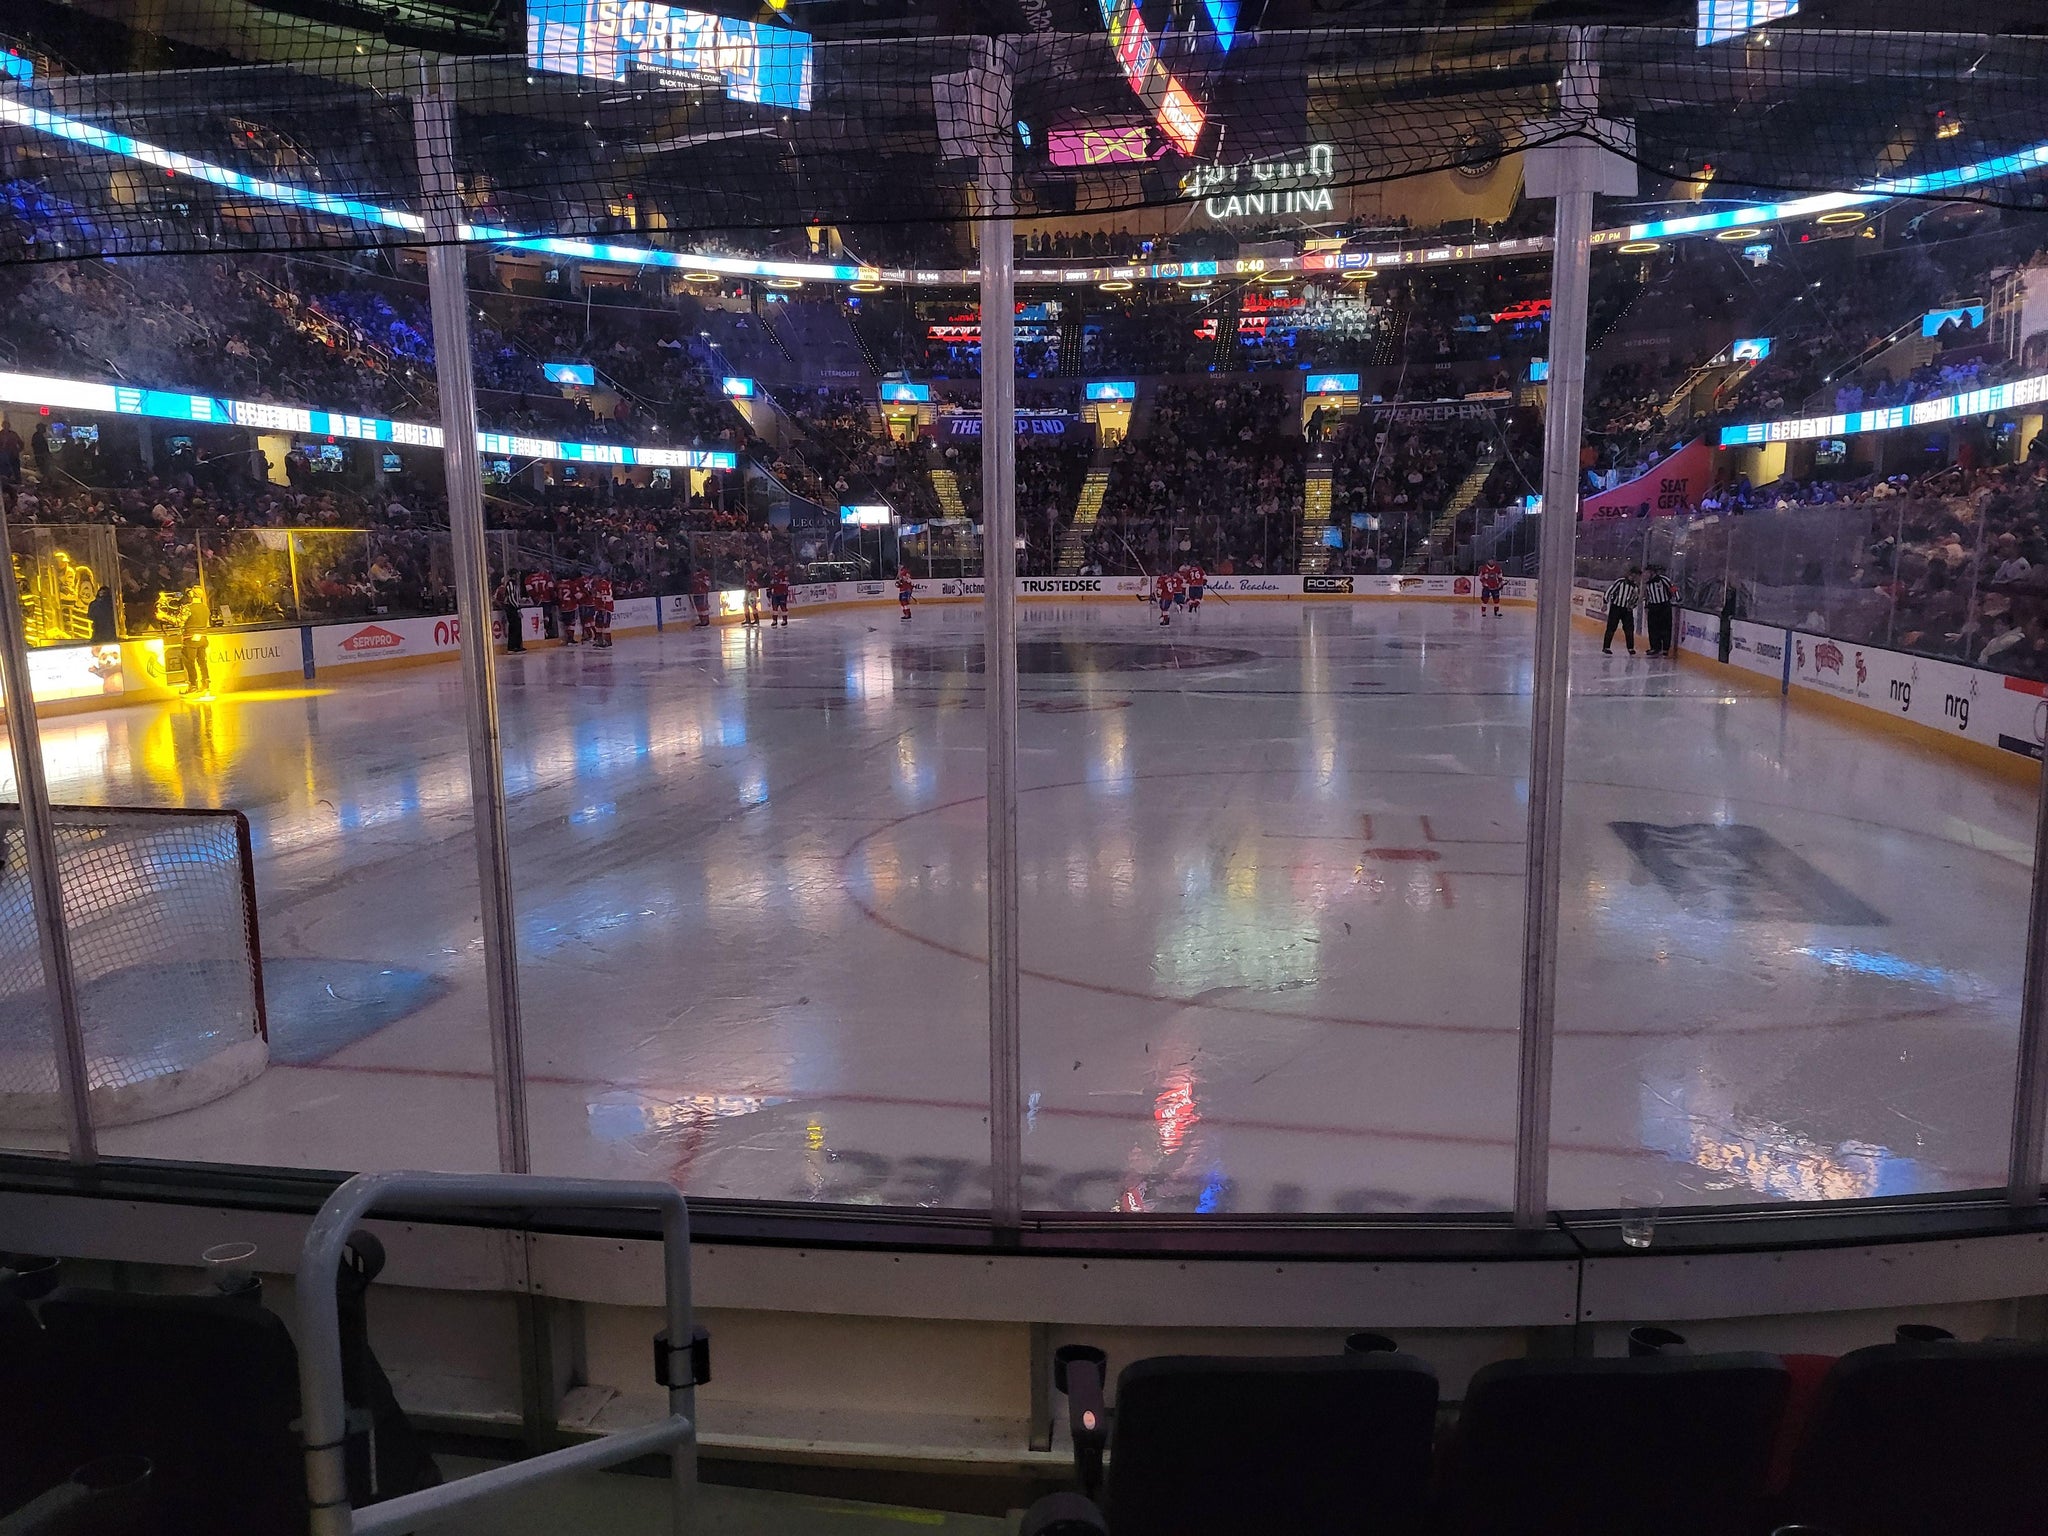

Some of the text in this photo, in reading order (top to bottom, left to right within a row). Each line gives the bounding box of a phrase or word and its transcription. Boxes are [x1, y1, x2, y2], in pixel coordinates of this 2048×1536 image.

[1206, 188, 1334, 219] CANTINA
[1608, 232, 1621, 241] PM
[1405, 252, 1414, 263] 3
[1455, 247, 1464, 258] 6
[1138, 267, 1146, 278] 3
[1236, 259, 1265, 273] 0:40
[1093, 269, 1101, 280] 7
[1373, 408, 1408, 424] THE
[1411, 406, 1453, 422] DEEP
[951, 419, 982, 435] THE
[1032, 419, 1066, 435] END
[1660, 478, 1689, 493] SEAT
[1022, 579, 1101, 593] TRUSTEDSEC
[352, 634, 392, 649] SERVPRO
[234, 646, 281, 661] MUTUAL
[1890, 678, 1912, 712] nrg
[1945, 692, 1970, 731] nrg
